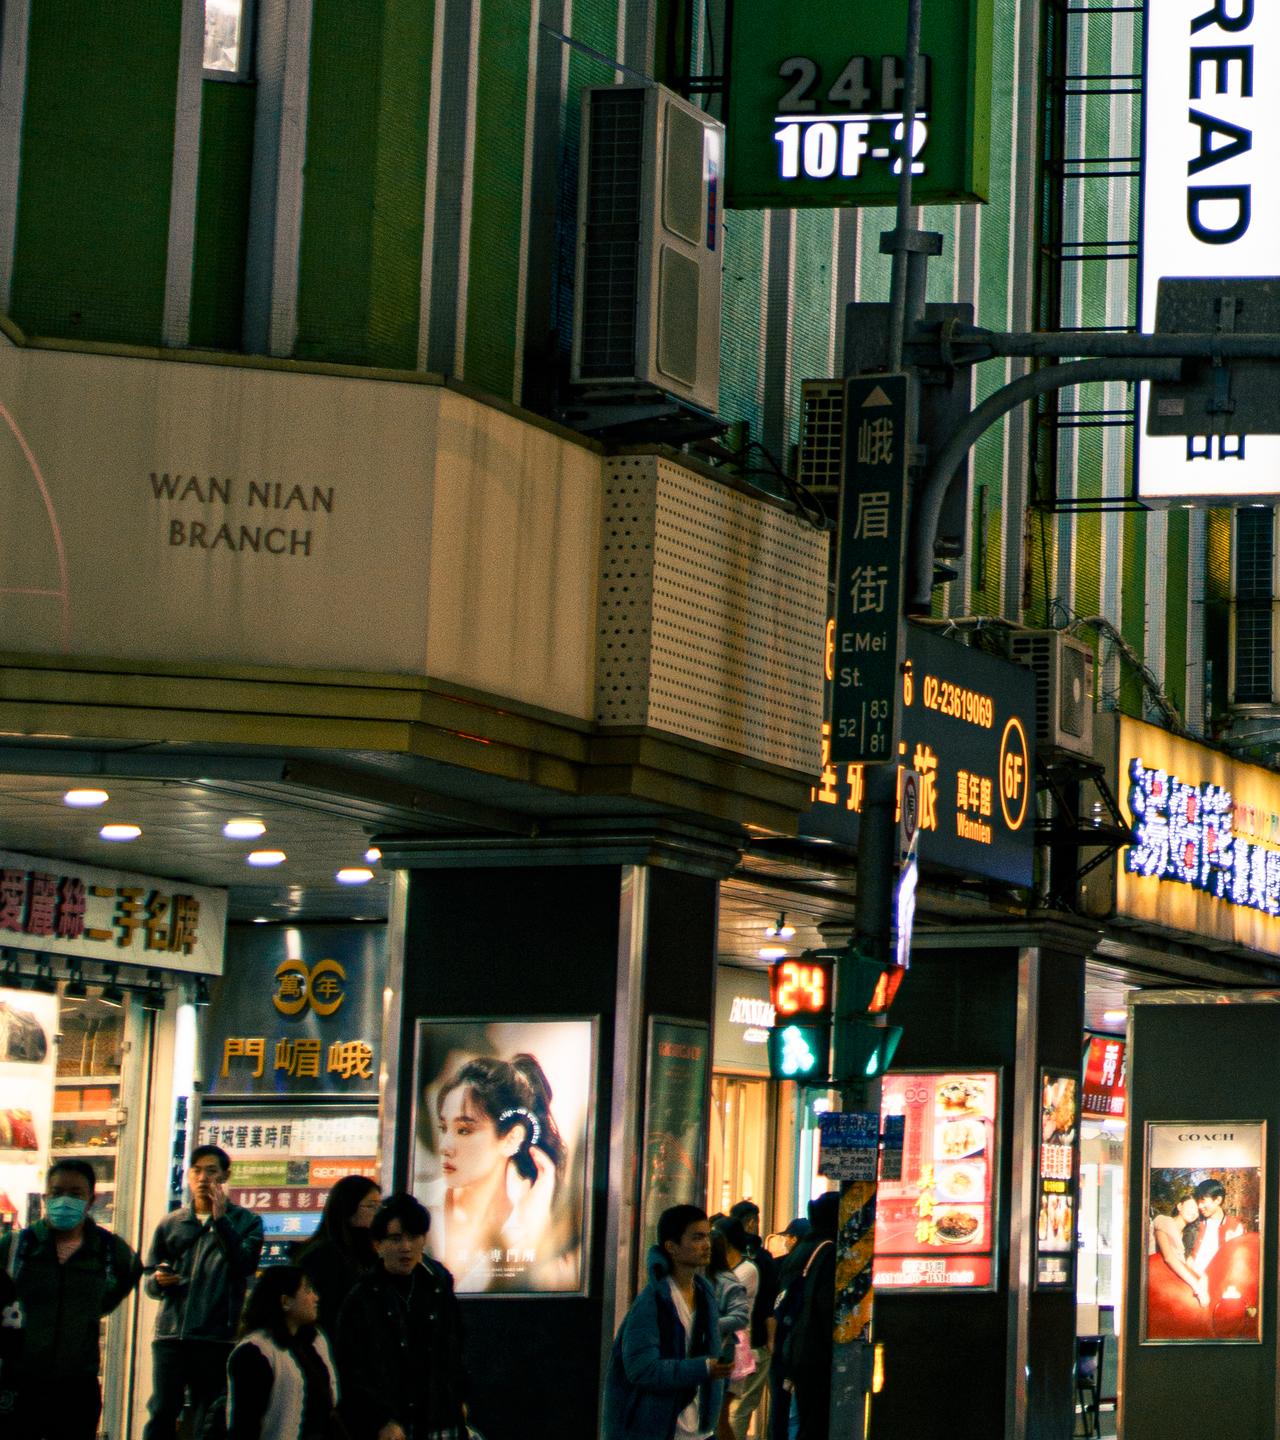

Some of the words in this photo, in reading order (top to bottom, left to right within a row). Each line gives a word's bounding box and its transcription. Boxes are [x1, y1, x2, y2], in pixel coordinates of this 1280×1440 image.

[774, 121, 928, 181] 10F-2
[149, 472, 233, 505] WAN
[247, 480, 335, 515] NIAN
[849, 417, 893, 616] 峨眉街
[167, 519, 314, 558] BRANCH
[842, 631, 887, 652] EMei
[840, 668, 863, 687] St.
[923, 674, 993, 730] 02-23619069
[838, 720, 856, 738] 52
[956, 770, 992, 817] 萬年館
[1005, 752, 1023, 799] 6F
[956, 812, 992, 845] Wannien
[778, 962, 825, 1012] 24
[1178, 1132, 1235, 1143] COACH
[239, 1192, 272, 1210] U2
